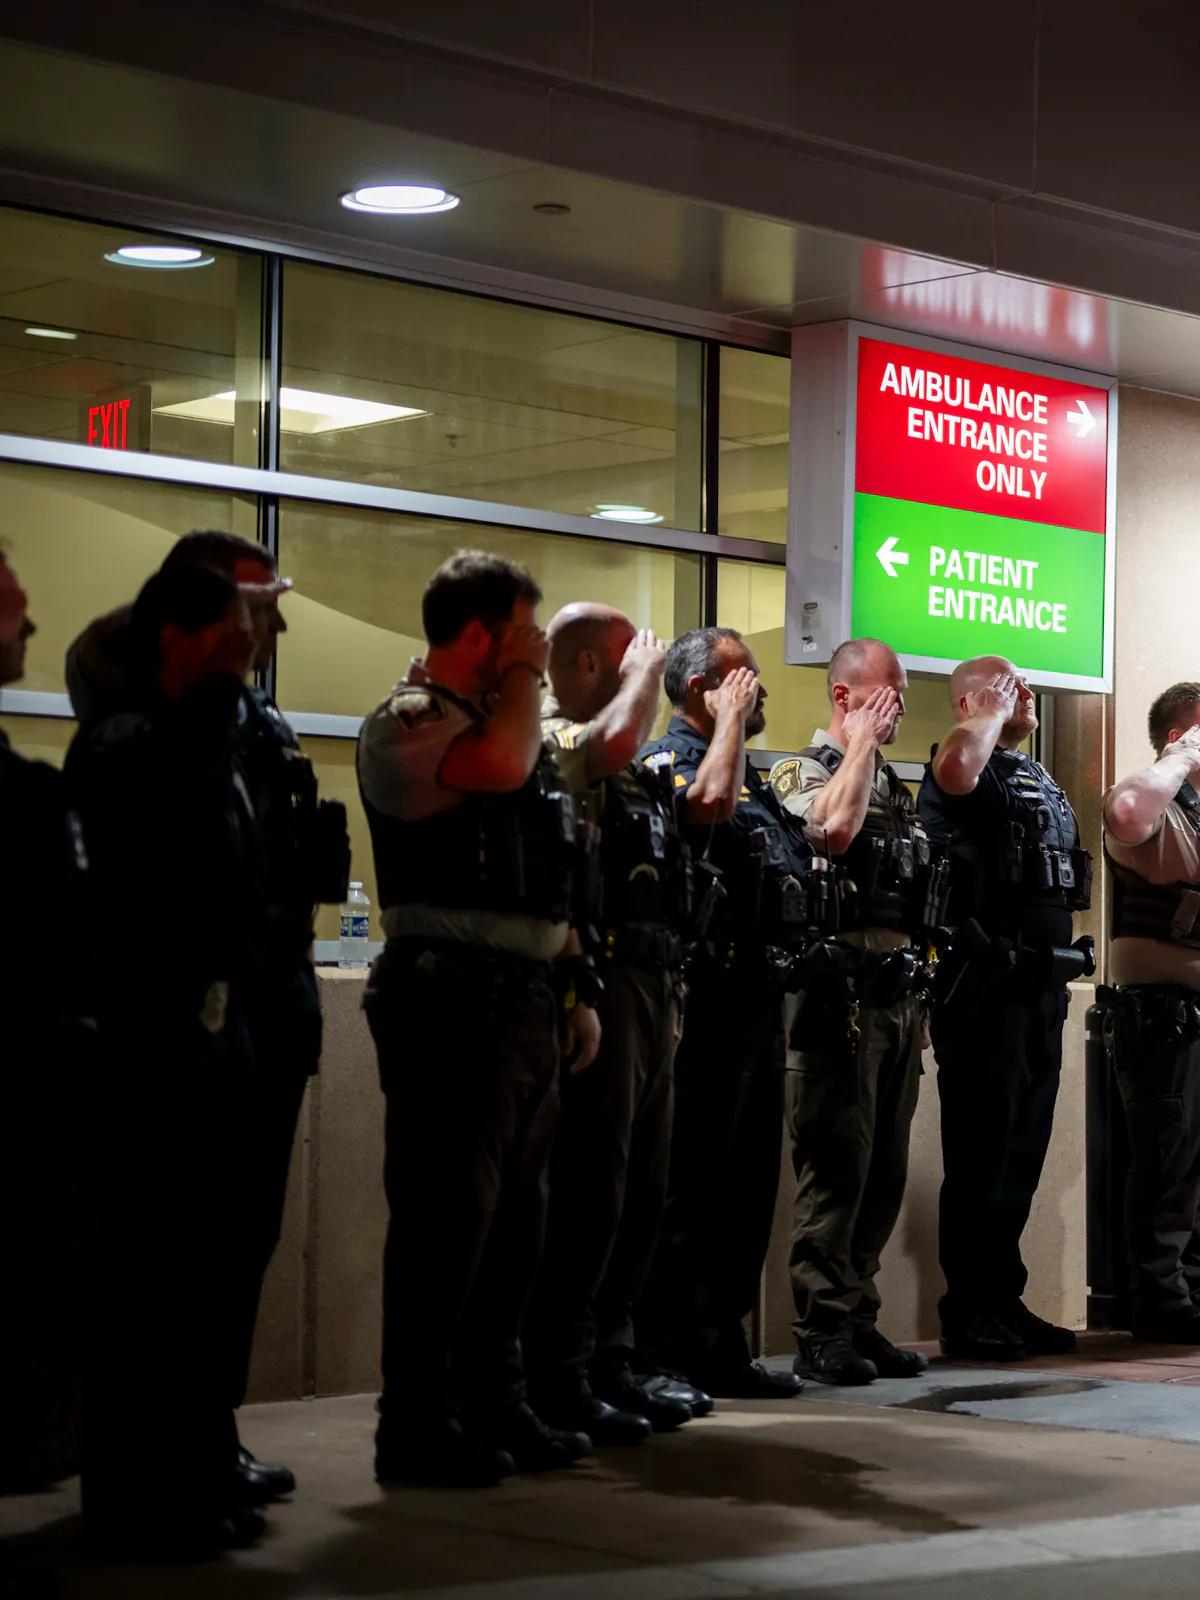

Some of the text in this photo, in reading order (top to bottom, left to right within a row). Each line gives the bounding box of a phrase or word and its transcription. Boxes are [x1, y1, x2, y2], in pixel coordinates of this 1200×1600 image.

[880, 362, 1048, 424] AMBULANCE
[88, 399, 130, 451] EXIT
[908, 407, 1048, 463] ENTRANCE
[976, 460, 1048, 500] ONLY
[929, 546, 1039, 590] PATIENT
[928, 585, 1067, 633] ENTRANCE
